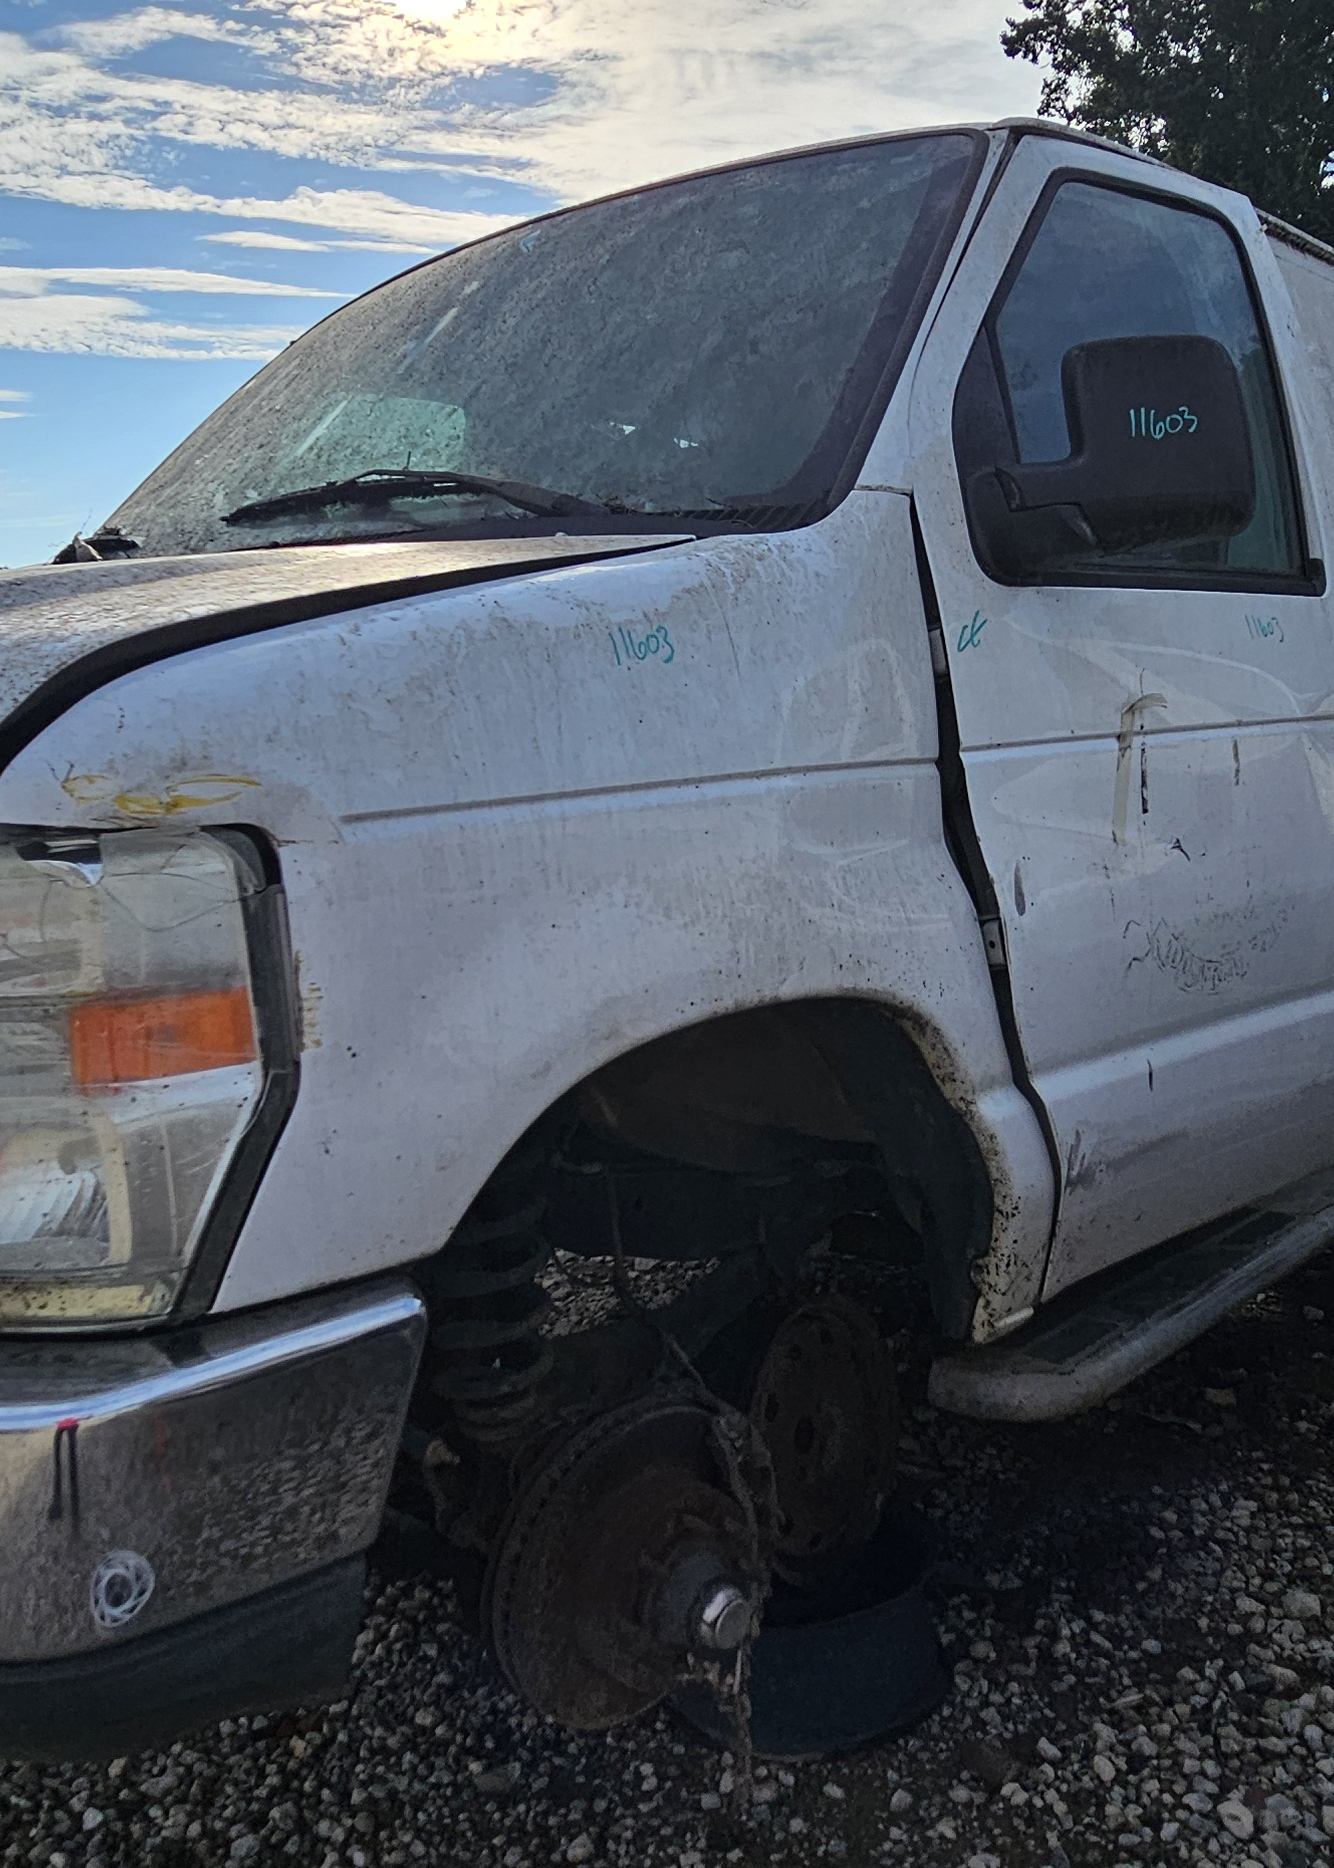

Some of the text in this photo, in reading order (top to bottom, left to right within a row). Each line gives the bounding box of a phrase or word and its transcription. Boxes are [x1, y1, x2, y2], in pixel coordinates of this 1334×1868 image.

[1130, 406, 1198, 439] 11603
[608, 624, 675, 666] 11603
[1244, 614, 1284, 643] 11603
